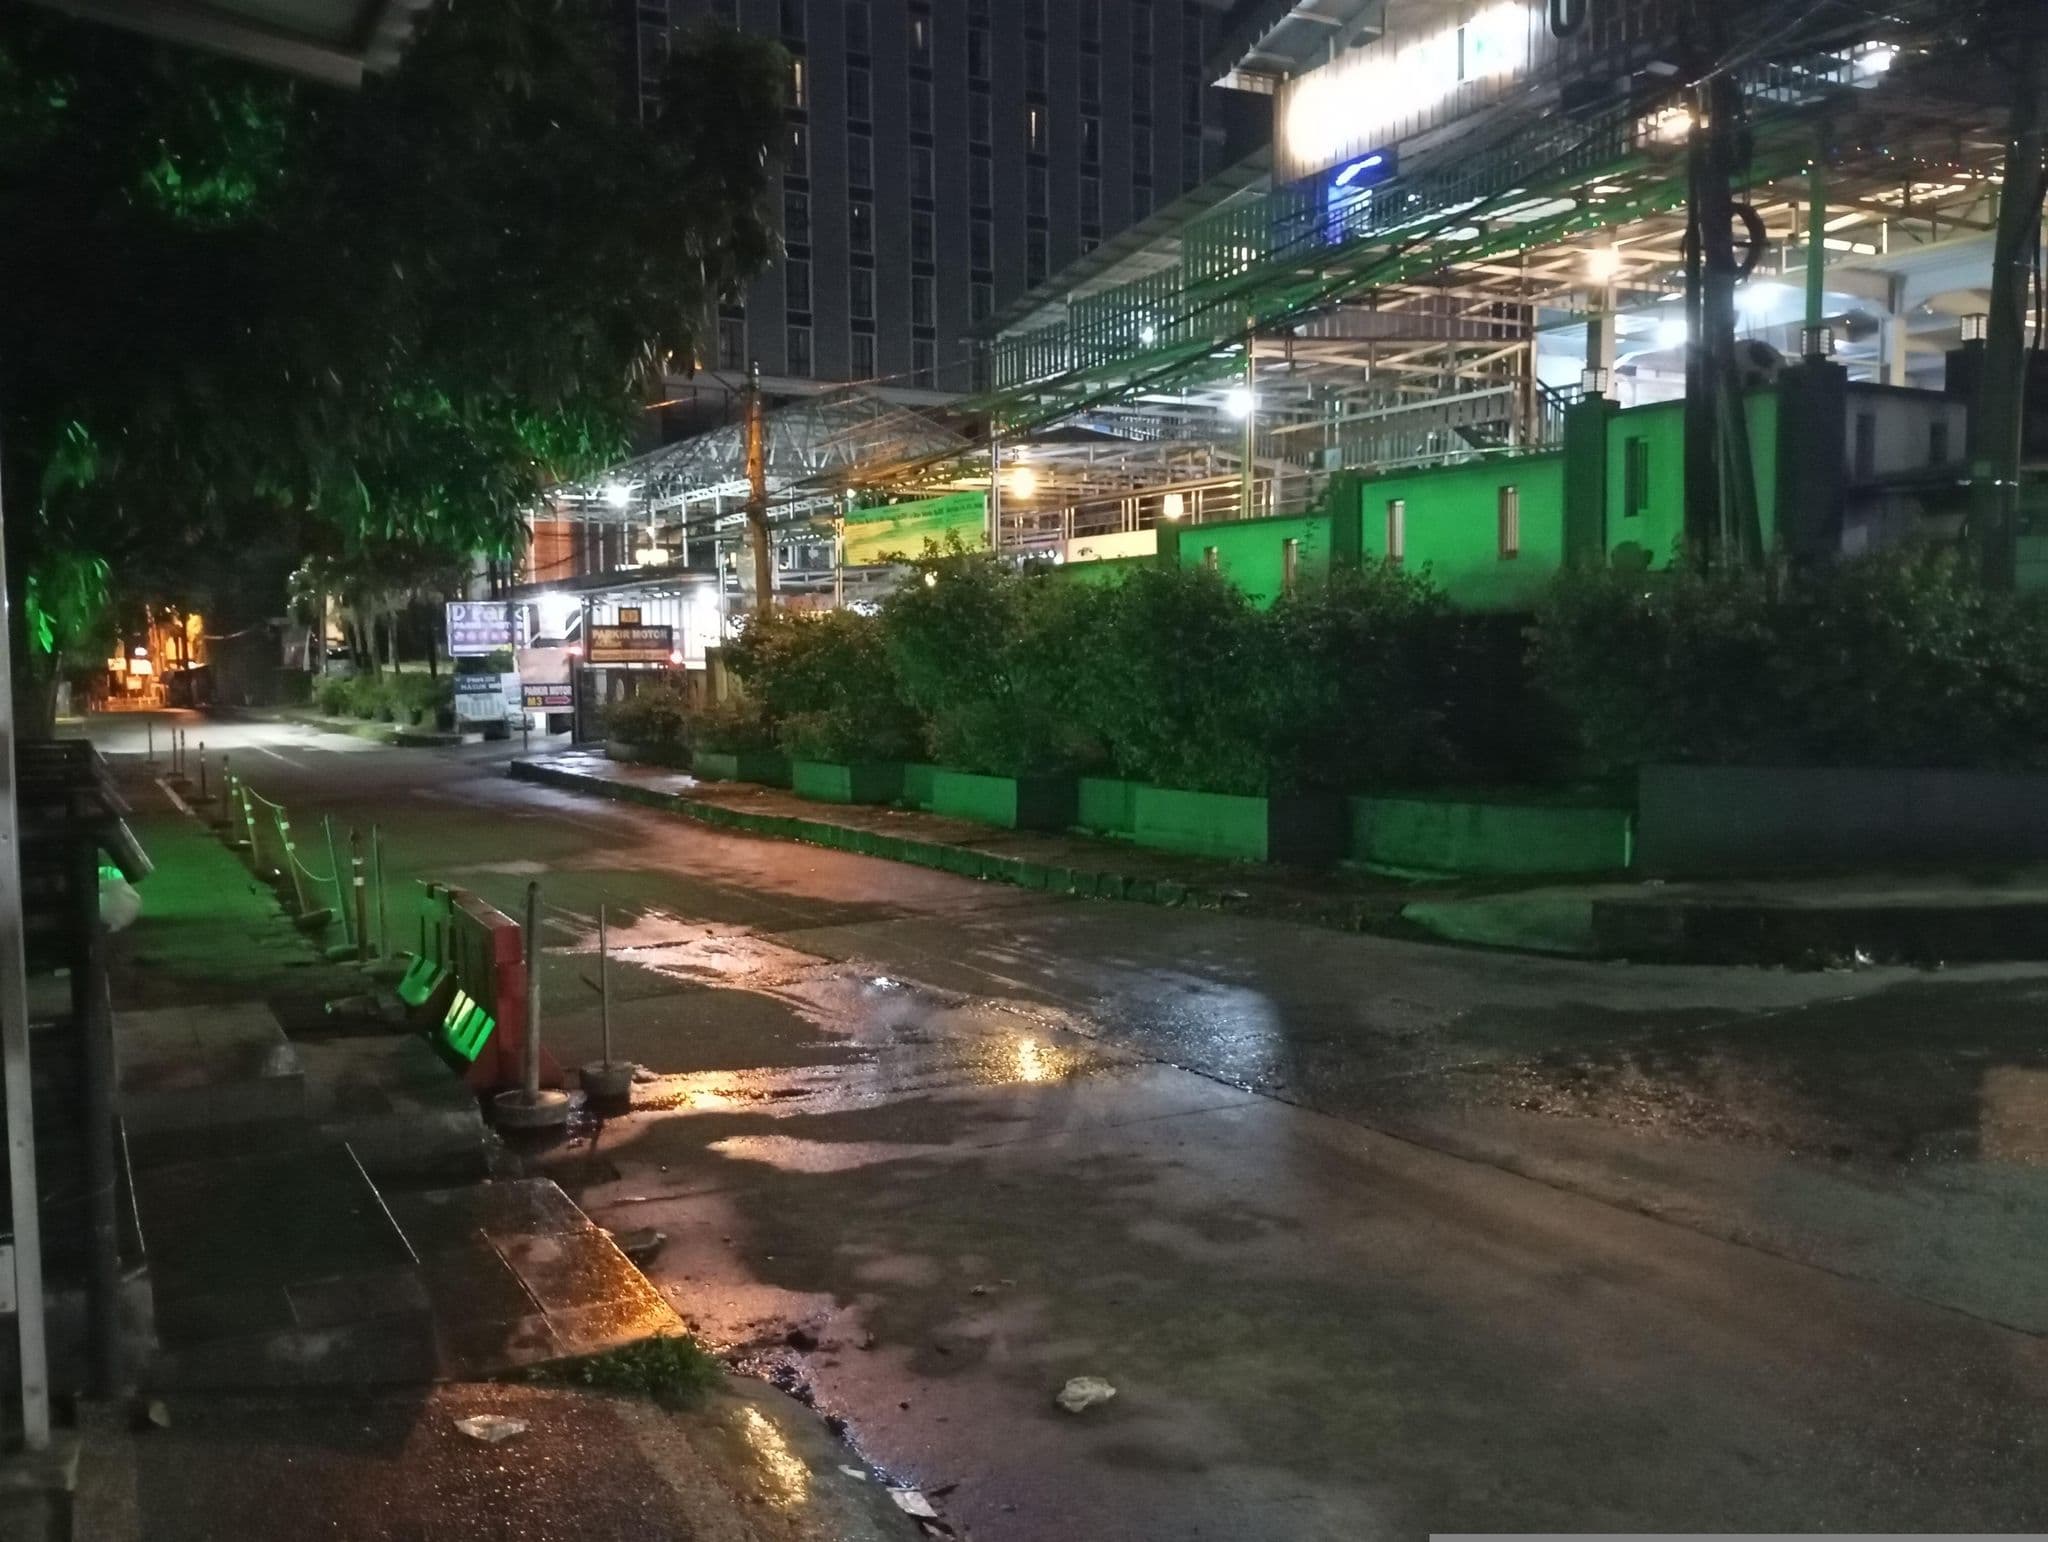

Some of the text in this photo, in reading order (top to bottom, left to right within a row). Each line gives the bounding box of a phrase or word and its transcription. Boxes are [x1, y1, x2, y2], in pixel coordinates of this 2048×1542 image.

[591, 628, 630, 640] PARKIR
[632, 629, 668, 640] MOTOR
[523, 685, 572, 696] PARKIR MOTOR
[527, 696, 543, 706] M3
